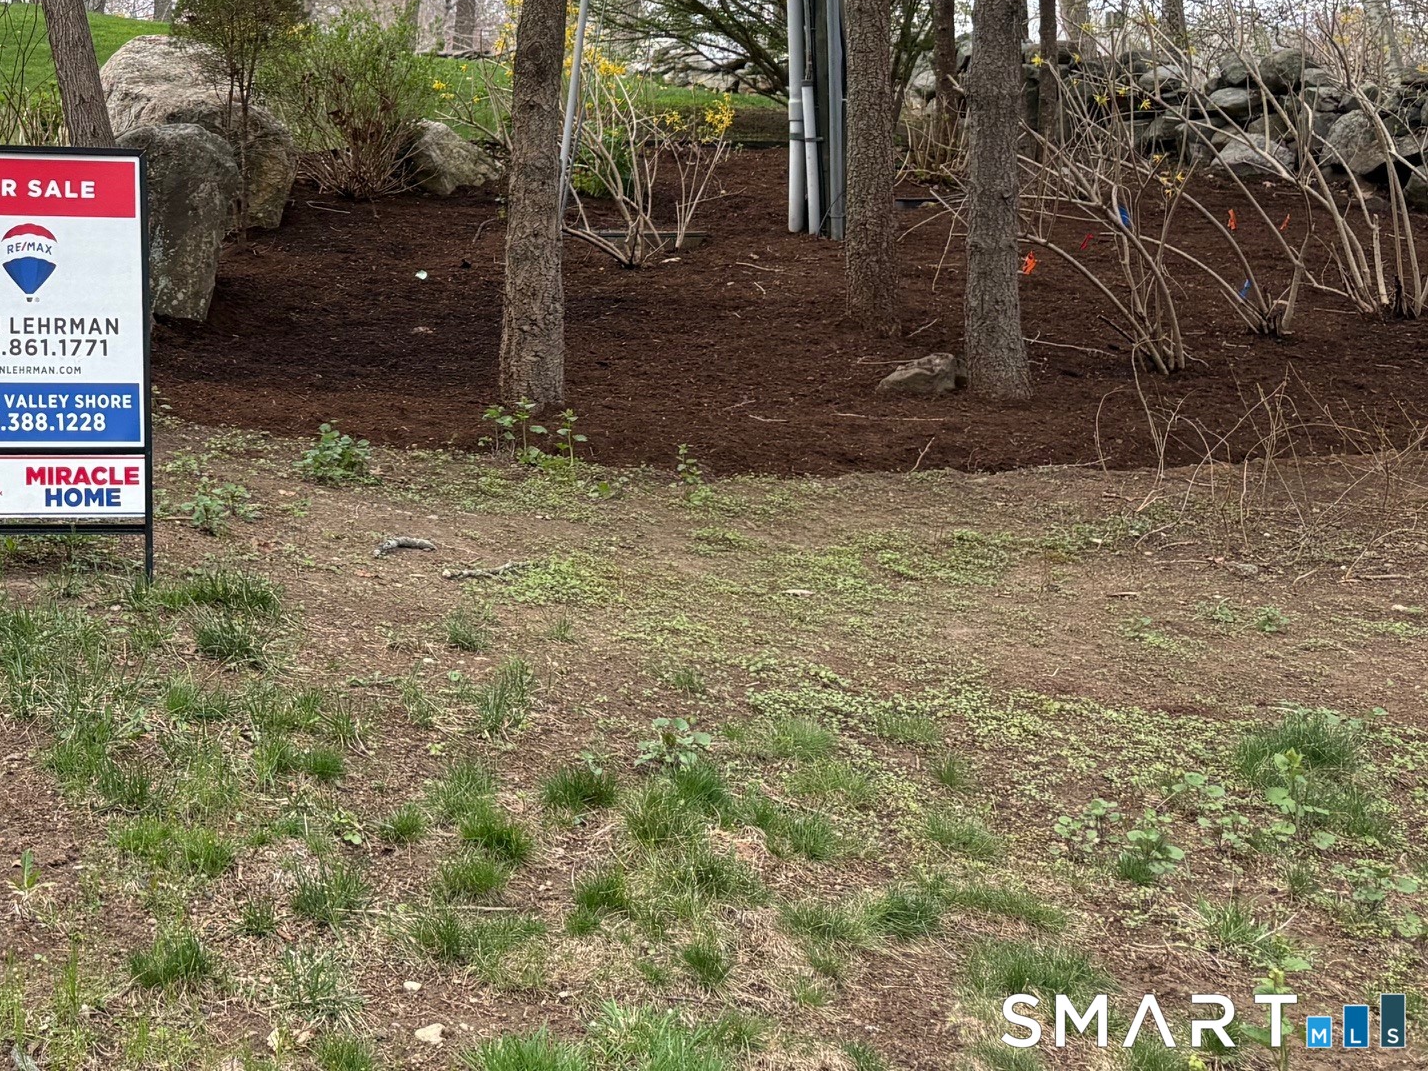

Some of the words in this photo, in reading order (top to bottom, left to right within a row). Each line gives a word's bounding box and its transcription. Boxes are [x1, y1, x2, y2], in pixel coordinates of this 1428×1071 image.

[27, 179, 96, 199] SALE
[7, 242, 52, 255] RE/MAX
[10, 317, 119, 335] LEHRMAN
[4, 394, 69, 409] VALLEY
[74, 394, 132, 409] SHORE
[25, 466, 140, 485] MIRACLE
[45, 488, 121, 507] HOME
